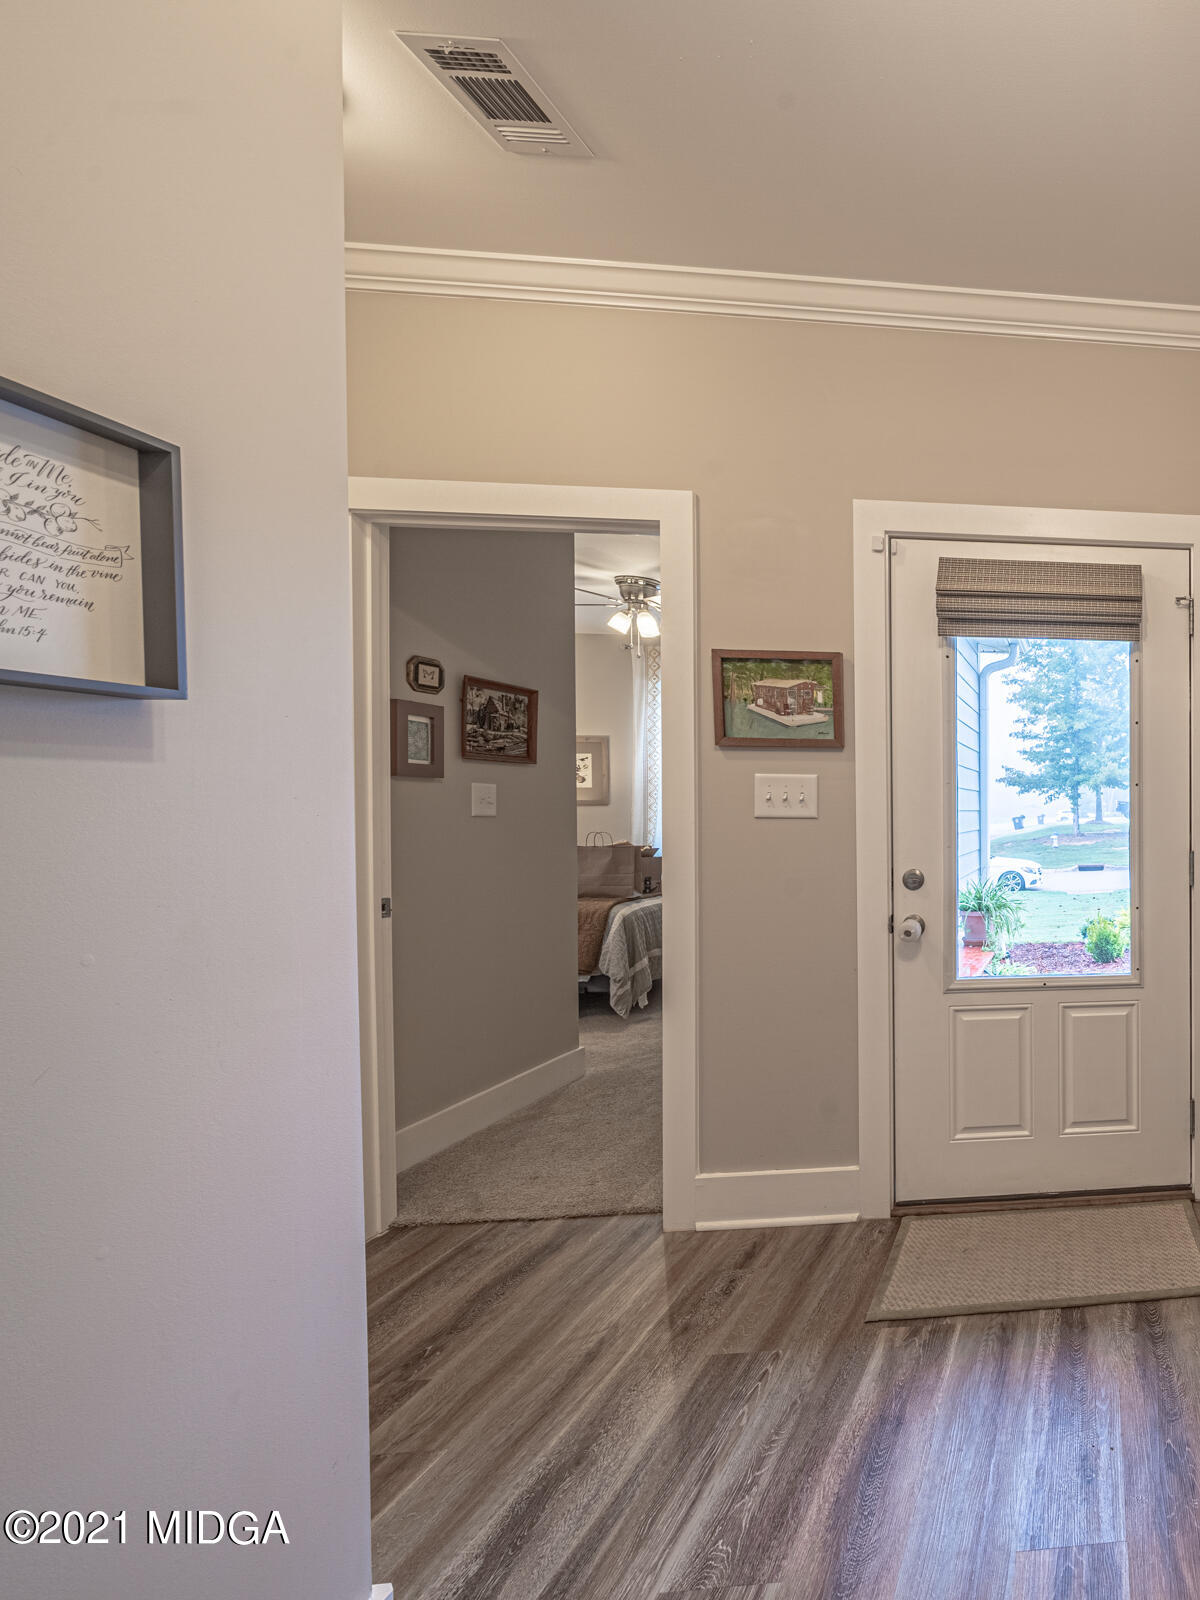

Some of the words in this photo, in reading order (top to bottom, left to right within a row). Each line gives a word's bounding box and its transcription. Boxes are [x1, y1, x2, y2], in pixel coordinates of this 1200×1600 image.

[25, 459, 39, 470] IN
[45, 486, 87, 506] you
[31, 535, 60, 554] bear
[88, 551, 120, 563] alone
[19, 571, 46, 585] CAN
[64, 564, 89, 578] the
[87, 569, 123, 583] vine
[2, 584, 36, 601] you
[41, 589, 96, 612] remain
